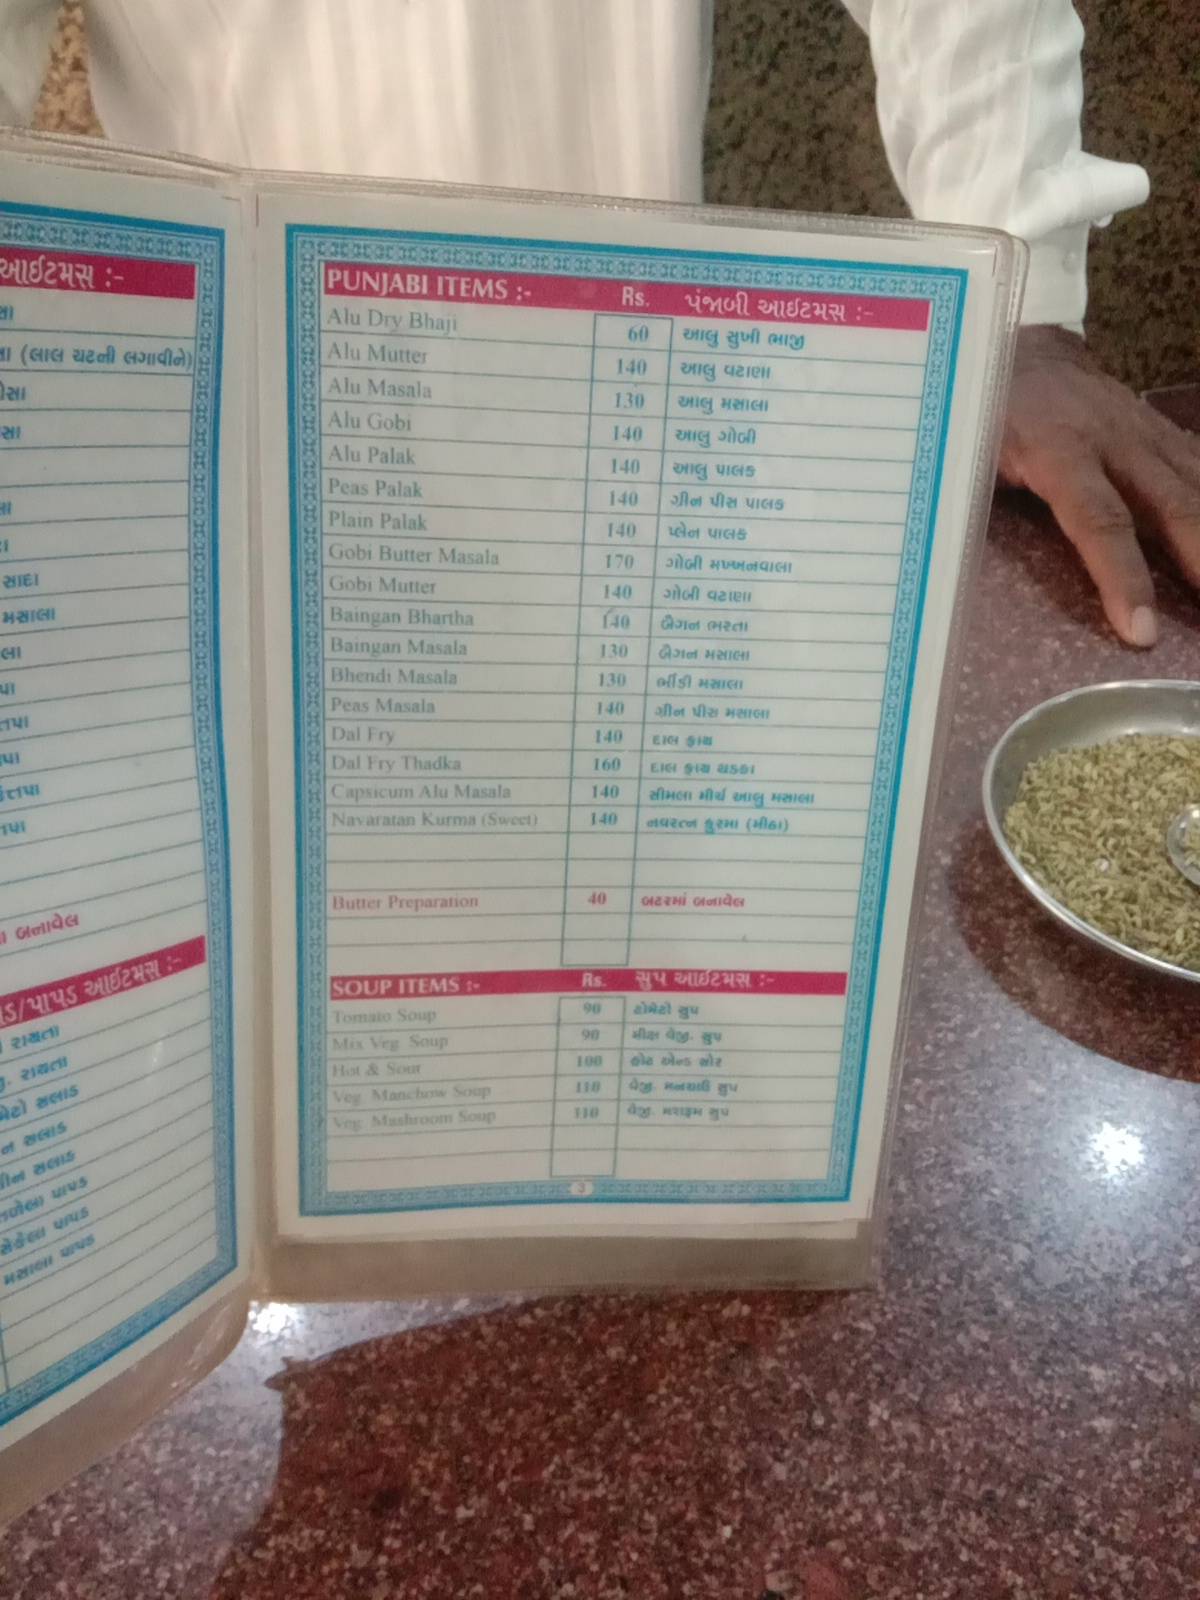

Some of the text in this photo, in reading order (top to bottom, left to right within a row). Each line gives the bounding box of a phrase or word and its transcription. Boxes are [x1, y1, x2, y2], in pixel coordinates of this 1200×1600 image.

[327, 269, 428, 296] PUNJABI
[437, 276, 508, 299] ITEMS
[622, 287, 649, 307] Rs.
[327, 308, 457, 335] Alu Dry Bhaji
[627, 325, 649, 341] 60
[683, 326, 719, 347] આલુ
[327, 342, 427, 364] Alu Mutter
[617, 358, 646, 376] 140
[680, 361, 716, 382] આલુ
[328, 377, 432, 399] Alu Masala
[615, 391, 644, 409] 130
[678, 394, 769, 414] આલુ મસાલા
[328, 411, 411, 432] Alu Gobi
[612, 425, 642, 442] 140
[675, 428, 711, 447] આલુ
[328, 445, 415, 465] Alu Palak
[611, 458, 640, 474] 140
[673, 461, 708, 480] આલુ
[328, 478, 423, 498] Peas Palak
[609, 490, 638, 506] 140
[328, 510, 428, 530] Plain Palak
[607, 522, 636, 538] 140
[328, 543, 499, 566] Gobi Butter Masala
[605, 554, 634, 570] 170
[329, 575, 436, 595] Gobi Mutter
[603, 584, 632, 600] 140
[330, 607, 474, 628] Baingan Bhartha
[602, 614, 630, 630] 140
[330, 637, 468, 657] Baingan Masala
[600, 644, 628, 659] 130
[331, 667, 458, 686] Bhendi Masala
[599, 673, 626, 688] 130
[331, 697, 436, 714] Peas Masala
[597, 701, 624, 716] 140
[331, 726, 395, 746] Dal Fry
[595, 729, 623, 744] 140
[331, 755, 462, 774] Dal Fry Thadka
[594, 758, 621, 772] 160
[331, 783, 512, 802] Capsicum Alu Masala
[592, 785, 619, 799] 140
[331, 812, 538, 828] Navaratan Kurma (Sweet)
[591, 812, 618, 826] 140
[332, 895, 478, 912] Butter Preparation
[588, 892, 607, 905] 40
[332, 979, 391, 996] SOUP
[399, 977, 459, 995] ITEMS
[582, 972, 607, 988] Rs.
[334, 1007, 436, 1026] Tomato Soup
[584, 1003, 601, 1014] 90
[332, 1037, 363, 1051] Mix
[409, 1033, 449, 1050] Soup
[582, 1029, 600, 1041] 90
[332, 1063, 360, 1077] Hot
[366, 1062, 379, 1077] &
[371, 1087, 448, 1103] Manchow
[452, 1083, 492, 1101] Soup
[458, 1109, 496, 1125] Soup
